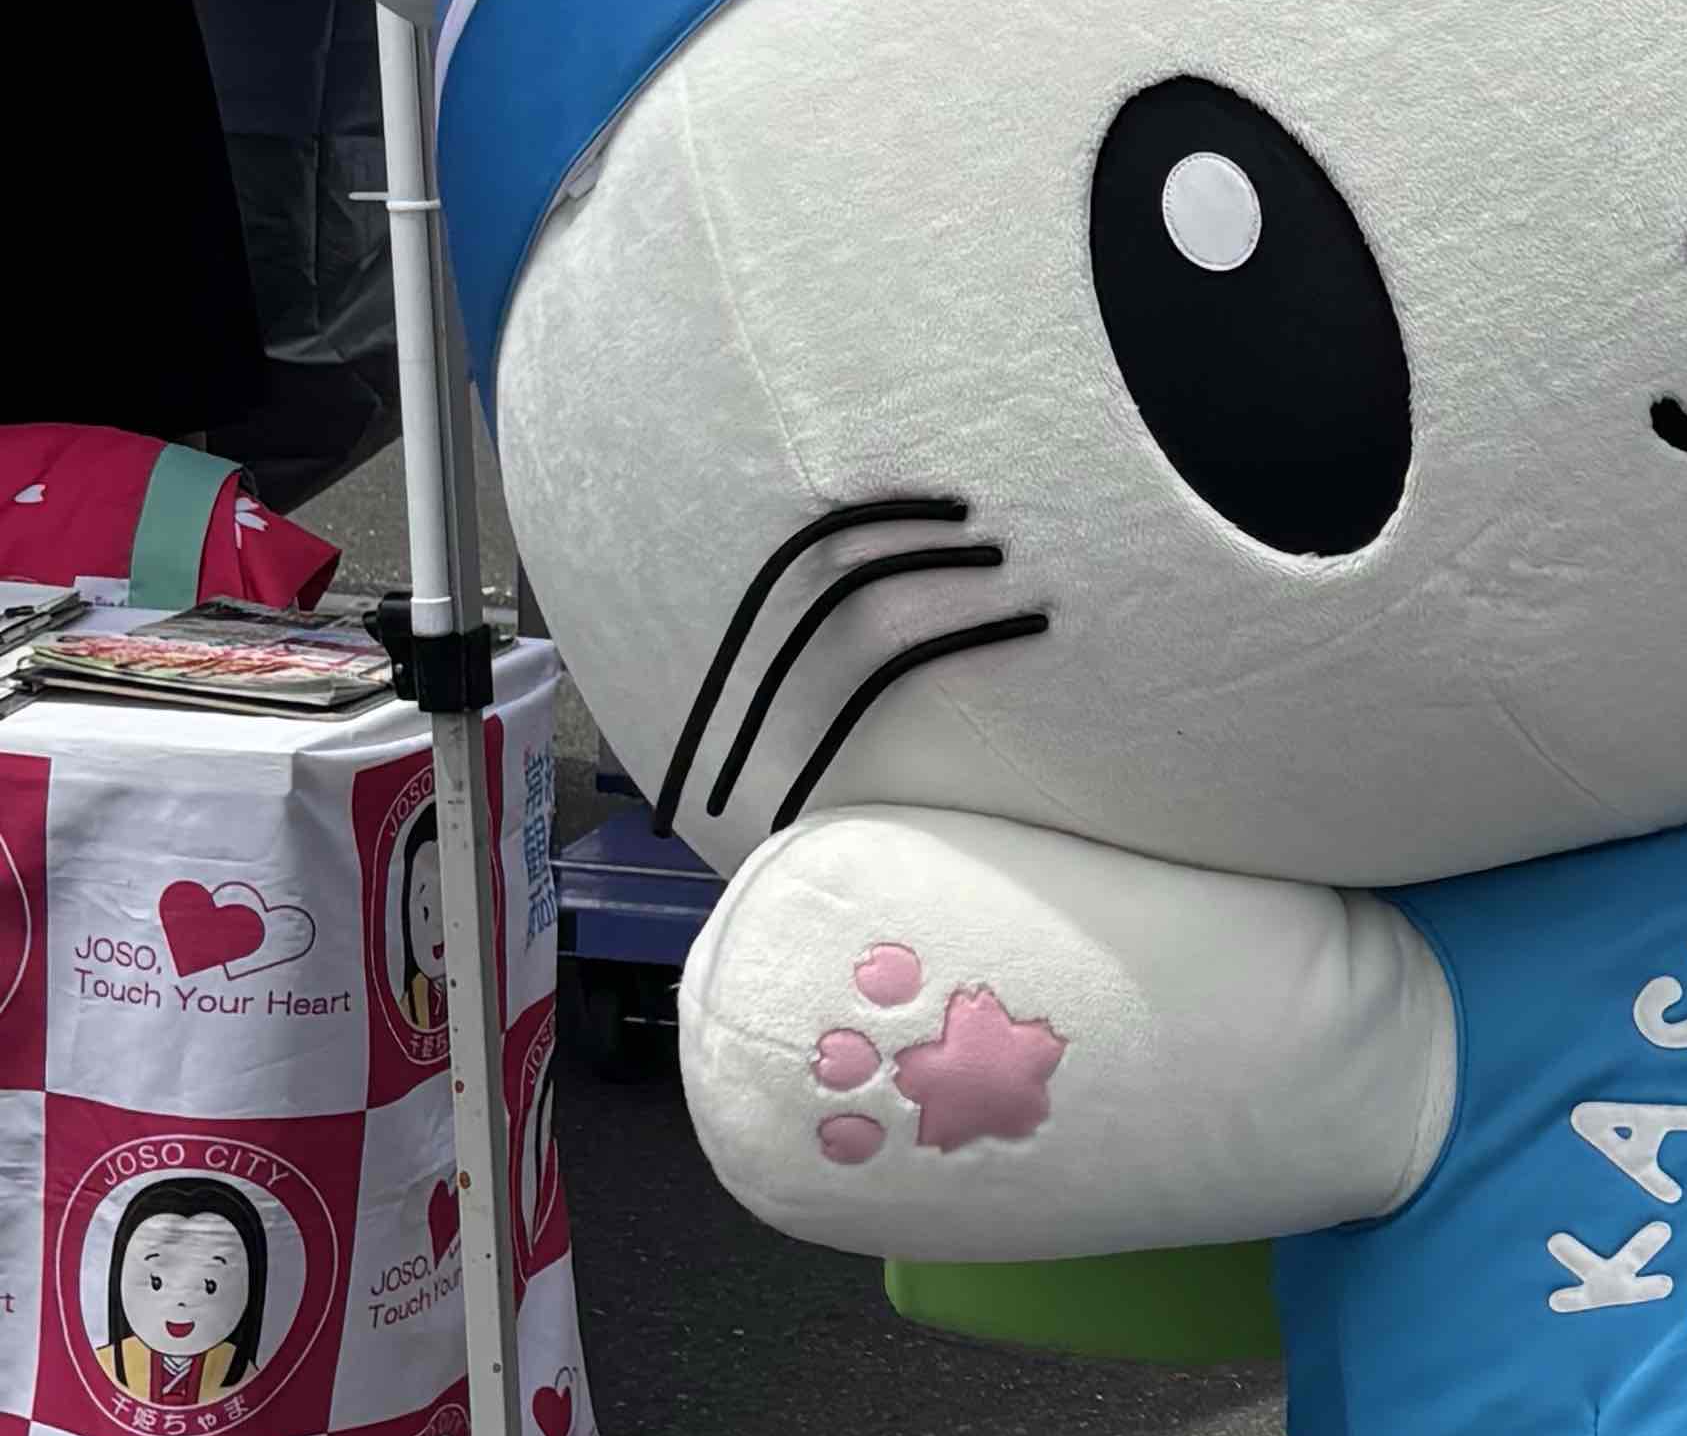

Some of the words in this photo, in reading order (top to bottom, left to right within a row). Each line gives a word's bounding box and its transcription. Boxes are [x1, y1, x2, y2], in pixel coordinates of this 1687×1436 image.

[74, 934, 162, 975] JOSO,
[73, 967, 161, 1008] Touch
[173, 984, 255, 1014] Your
[267, 990, 352, 1016] Heart
[103, 1141, 186, 1186] JOSO
[204, 1144, 289, 1188] CITY
[368, 1288, 432, 1329] Touch
[110, 1394, 249, 1435] 千姫ちゃま
